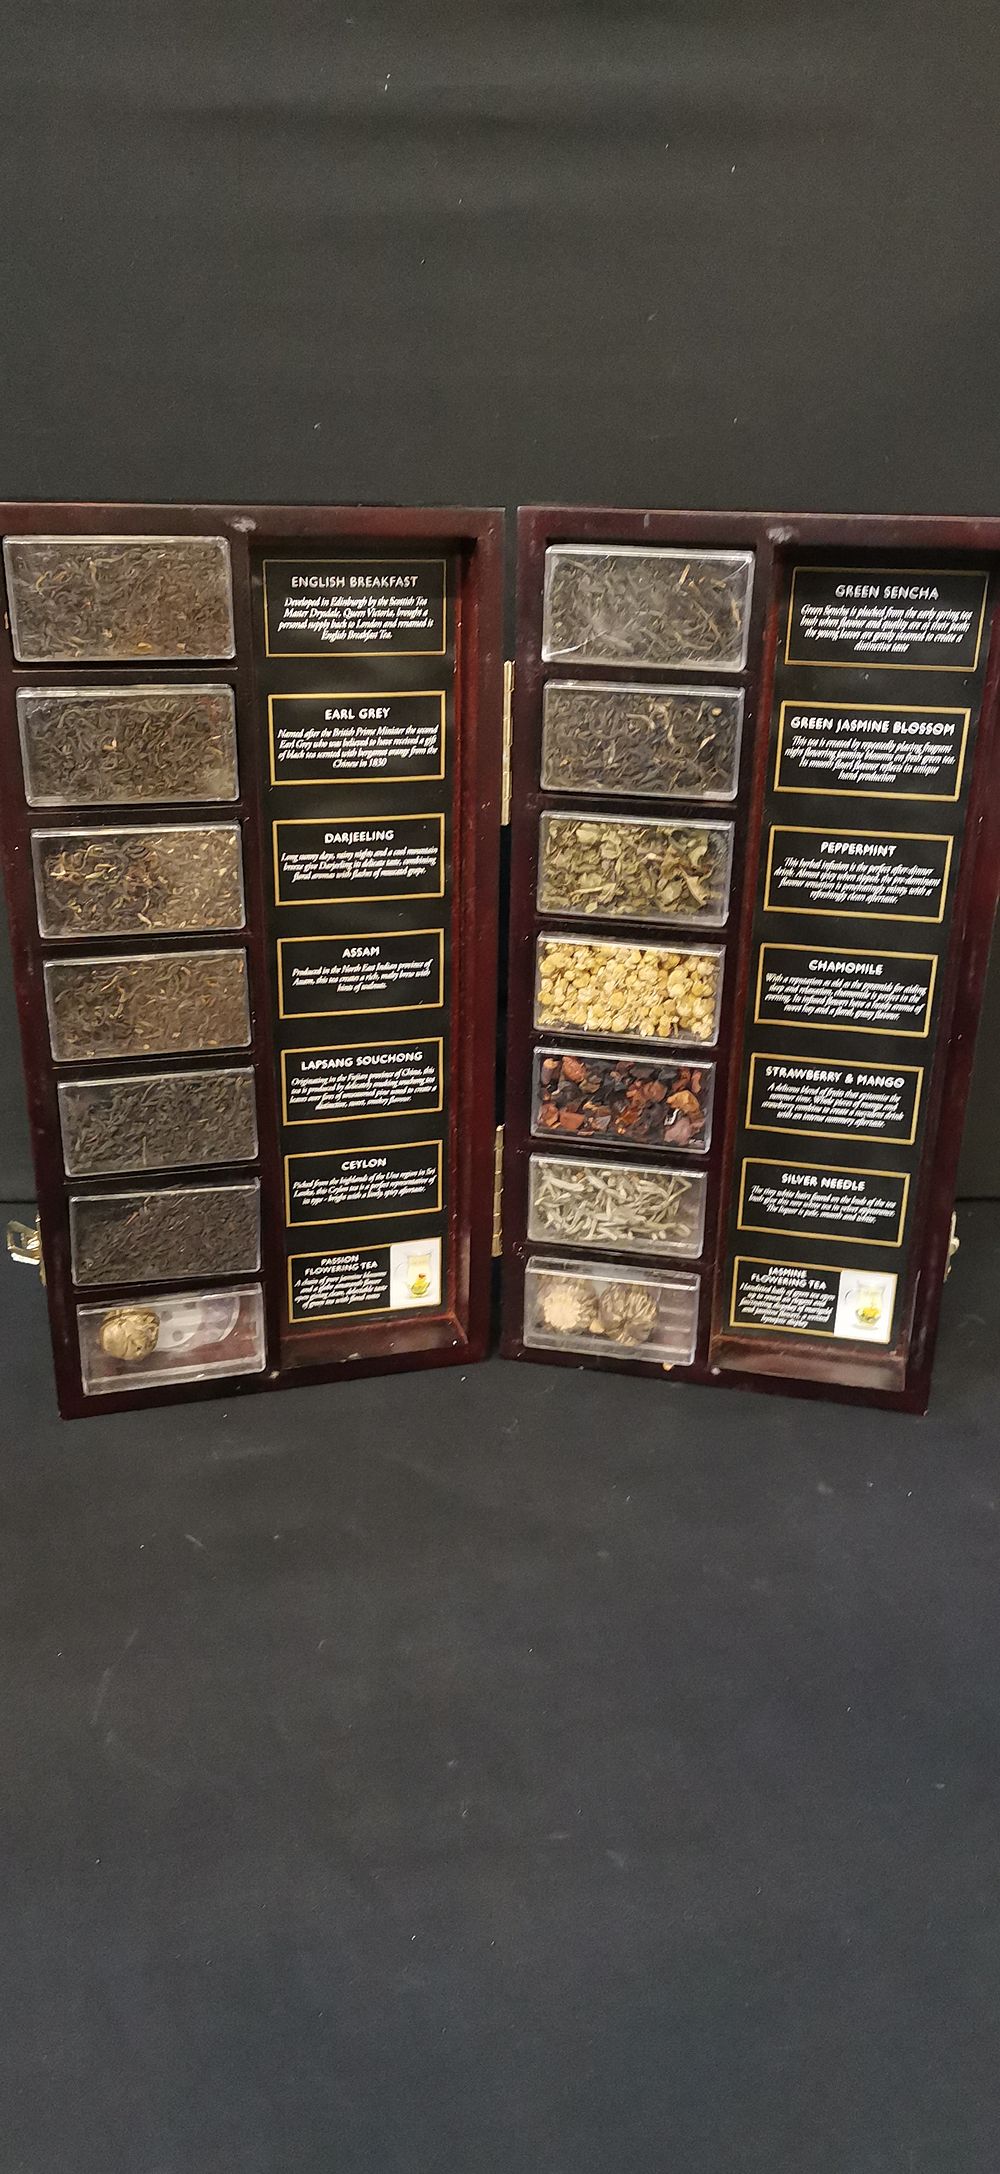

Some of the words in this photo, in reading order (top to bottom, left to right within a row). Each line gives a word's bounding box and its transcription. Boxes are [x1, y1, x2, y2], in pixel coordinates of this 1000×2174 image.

[292, 577, 345, 587] ENGLISH
[350, 576, 418, 588] BREAKFAST
[836, 585, 879, 598] GREEN
[884, 586, 938, 600] SENCHA
[283, 597, 320, 609] Developed
[321, 597, 329, 607] in
[330, 596, 366, 609] Edinburgh
[366, 595, 377, 609] by
[377, 596, 388, 606] the
[389, 596, 414, 606] Scottish
[415, 596, 428, 605] Tea
[283, 609, 308, 618] Master
[342, 608, 366, 619] Queen
[800, 604, 823, 616] Green
[822, 605, 849, 617] Sencha
[849, 605, 857, 616] is
[856, 605, 885, 620] plucked
[884, 606, 904, 621] from
[904, 607, 917, 618] the
[917, 607, 935, 620] early
[935, 609, 959, 622] spring
[960, 611, 973, 621] tea
[277, 619, 307, 631] personal
[307, 620, 330, 631] supply
[330, 619, 347, 628] back
[348, 620, 355, 628] to
[356, 618, 382, 628] London
[383, 618, 397, 627] and
[818, 615, 839, 627] when
[837, 616, 865, 631] flavour
[865, 618, 881, 628] and
[881, 618, 907, 632] quality
[907, 622, 920, 630] are
[920, 622, 928, 631] at
[928, 620, 949, 632] their
[320, 630, 346, 642] English
[347, 629, 378, 642] Breakfast
[804, 626, 818, 637] the
[816, 629, 839, 640] young
[838, 627, 860, 639] leaves
[872, 629, 895, 643] gently
[925, 632, 933, 641] to
[933, 632, 957, 642] create
[956, 634, 963, 643] a
[853, 640, 891, 652] distinctive
[890, 642, 909, 653] taste
[325, 709, 355, 720] EARL
[359, 708, 390, 719] GREY
[277, 728, 303, 739] Named
[303, 728, 320, 740] after
[321, 727, 332, 737] the
[332, 726, 355, 737] British
[355, 725, 376, 736] Prime
[376, 724, 405, 735] Minister
[405, 723, 416, 734] the
[416, 723, 439, 734] second
[791, 717, 833, 729] GREEN
[836, 719, 890, 733] JASMINE
[893, 721, 955, 736] BLOSSOM
[279, 739, 295, 749] Earl
[295, 738, 312, 751] Grey
[312, 738, 328, 748] who
[342, 737, 368, 747] believed
[369, 737, 376, 746] to
[376, 736, 393, 745] have
[393, 734, 418, 745] received
[423, 734, 437, 746] gift
[358, 758, 367, 767] in
[367, 757, 387, 768] 1830
[837, 770, 857, 780] hand
[856, 770, 896, 786] production
[325, 830, 394, 844] DARJEELING
[821, 842, 897, 857] PEPPERMINT
[342, 947, 379, 958] ASSAM
[809, 960, 883, 975] CHAMOMILE
[302, 1058, 353, 1070] LAPSANG
[356, 1052, 422, 1066] SOUCHONG
[766, 1065, 842, 1083] STRAWBERRY
[845, 1074, 853, 1083] &
[857, 1075, 904, 1088] MANGO
[341, 1158, 386, 1170] CEYLON
[782, 1174, 817, 1186] SILVER
[821, 1178, 865, 1191] NEEDLE
[321, 1255, 359, 1265] PASSION
[305, 1263, 359, 1276] FLOWERING
[361, 1261, 378, 1270] TEA
[768, 1267, 807, 1278] JASMINE
[751, 1274, 807, 1287] FLOWERING
[808, 1280, 827, 1290] TEA
